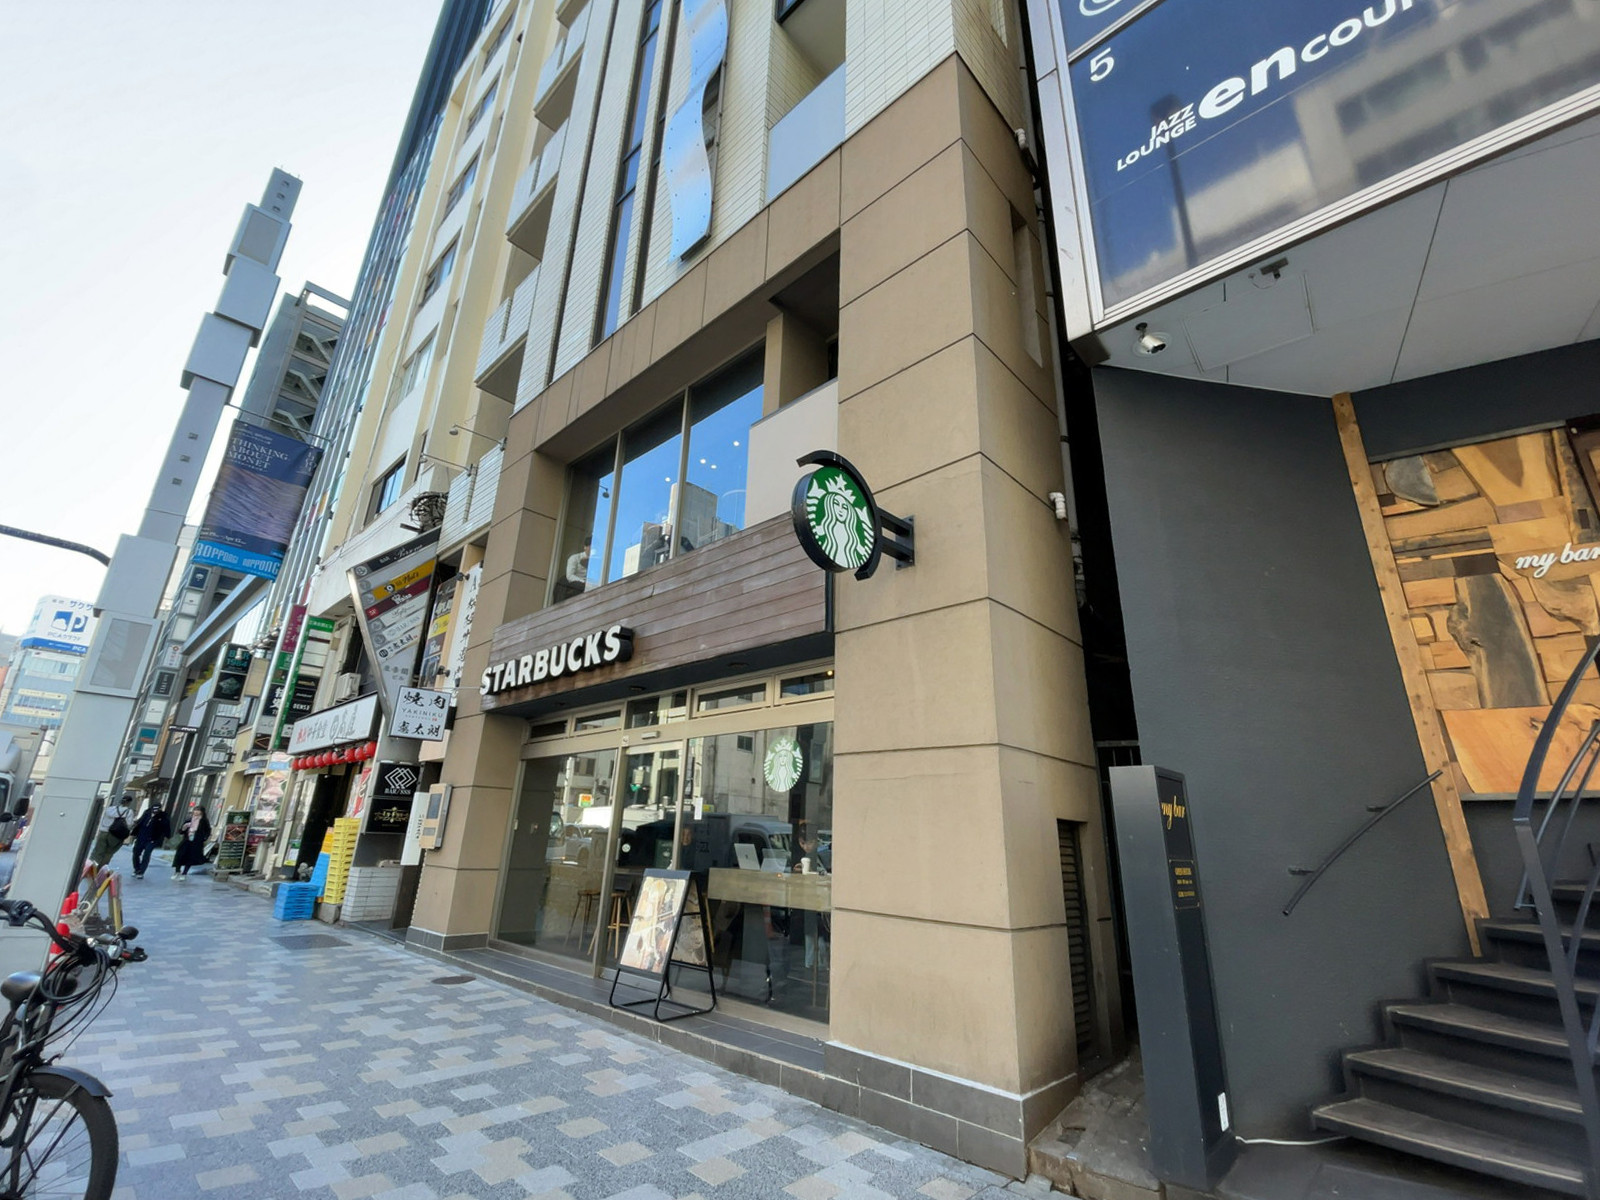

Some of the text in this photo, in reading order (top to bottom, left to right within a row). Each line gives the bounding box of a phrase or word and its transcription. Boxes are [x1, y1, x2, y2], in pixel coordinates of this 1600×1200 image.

[1090, 47, 1115, 82] 5
[1151, 102, 1195, 141] JAZZ
[1116, 116, 1198, 172] LOUNGE
[227, 450, 271, 469] MONET
[230, 445, 273, 462] ABOUT
[231, 437, 289, 461] THINKING
[1515, 552, 1558, 578] my
[479, 624, 625, 696] STARBUCKS
[401, 707, 443, 718] YAKINIKU
[402, 691, 446, 709] 焼肉
